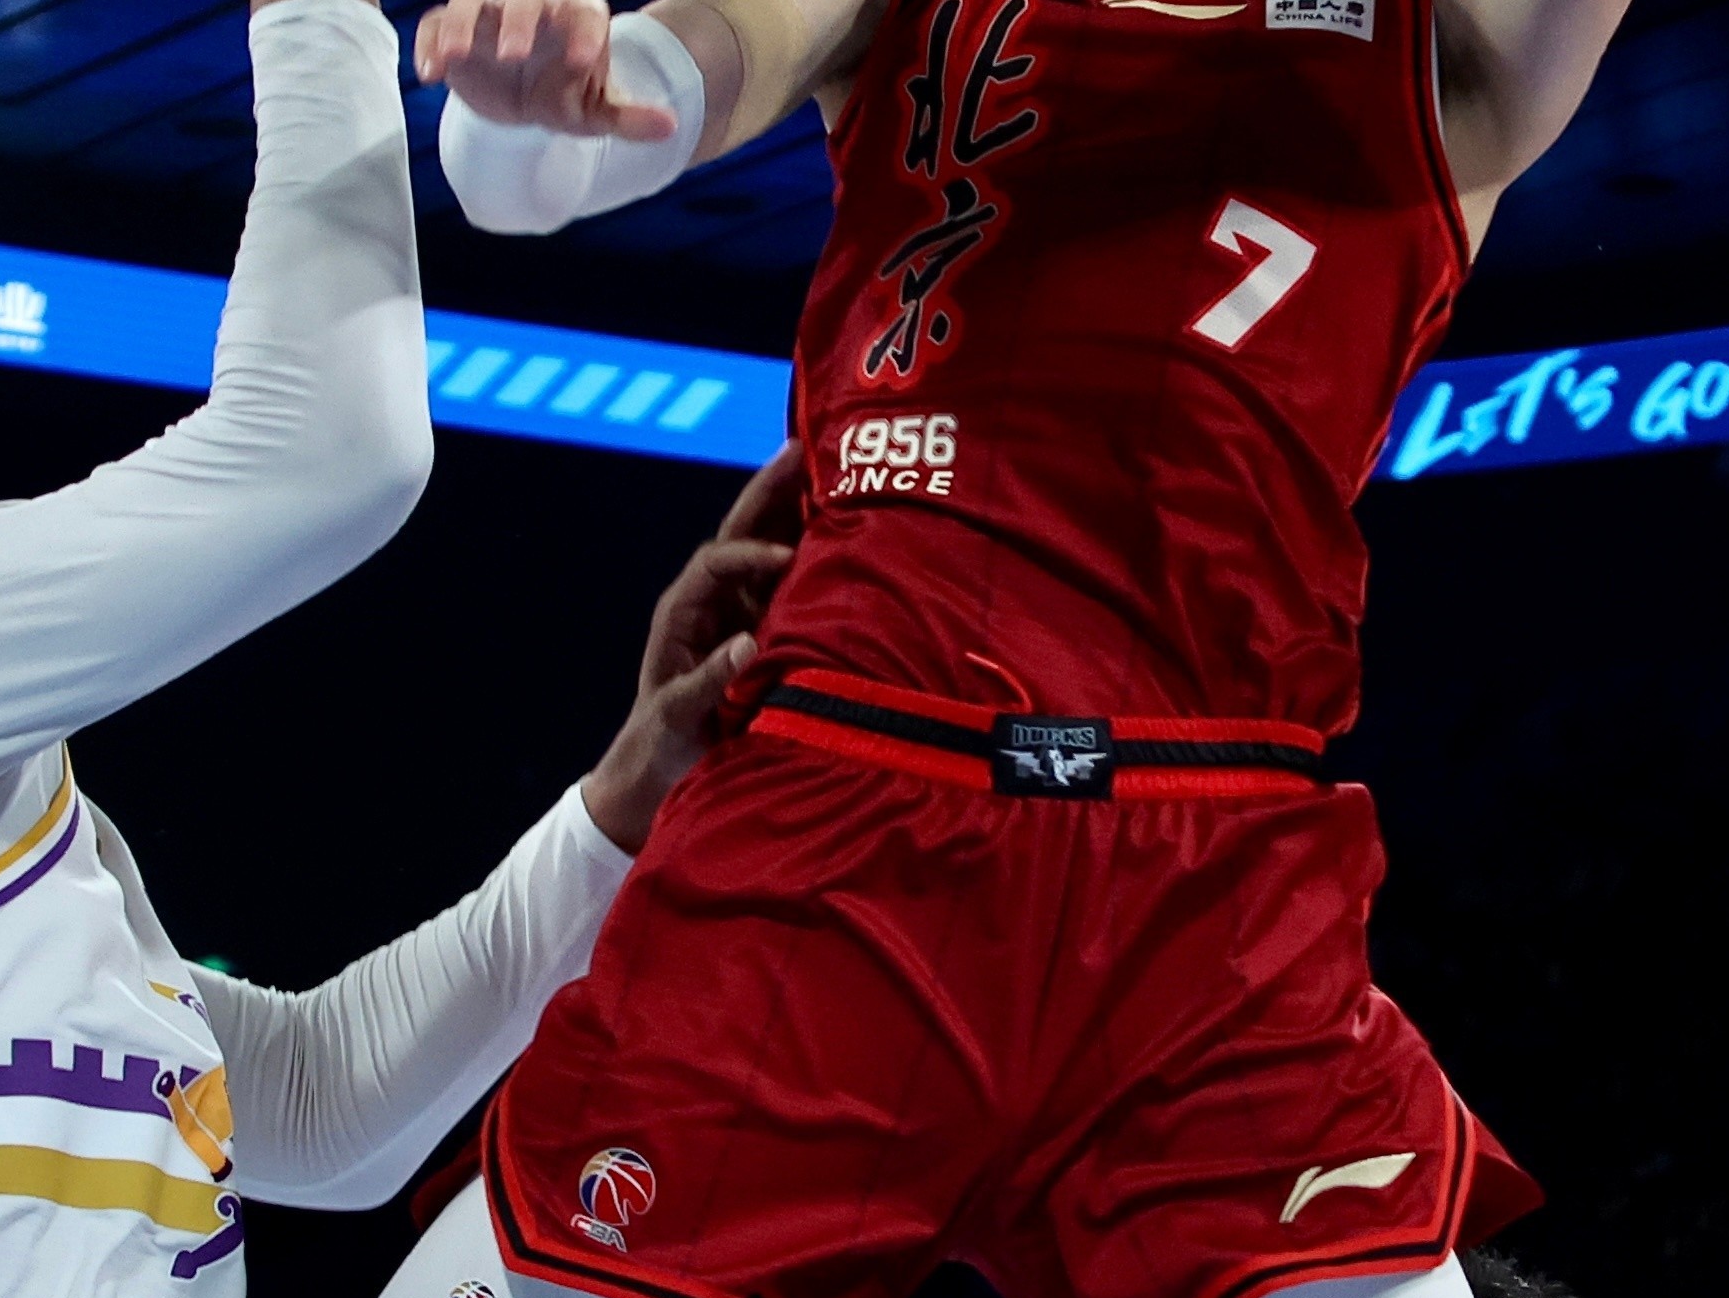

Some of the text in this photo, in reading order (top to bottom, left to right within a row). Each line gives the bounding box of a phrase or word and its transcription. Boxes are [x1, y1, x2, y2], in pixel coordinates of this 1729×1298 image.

[1274, 13, 1364, 28] CHINA LIFE
[1191, 198, 1318, 348] 7
[839, 412, 959, 472] 1956
